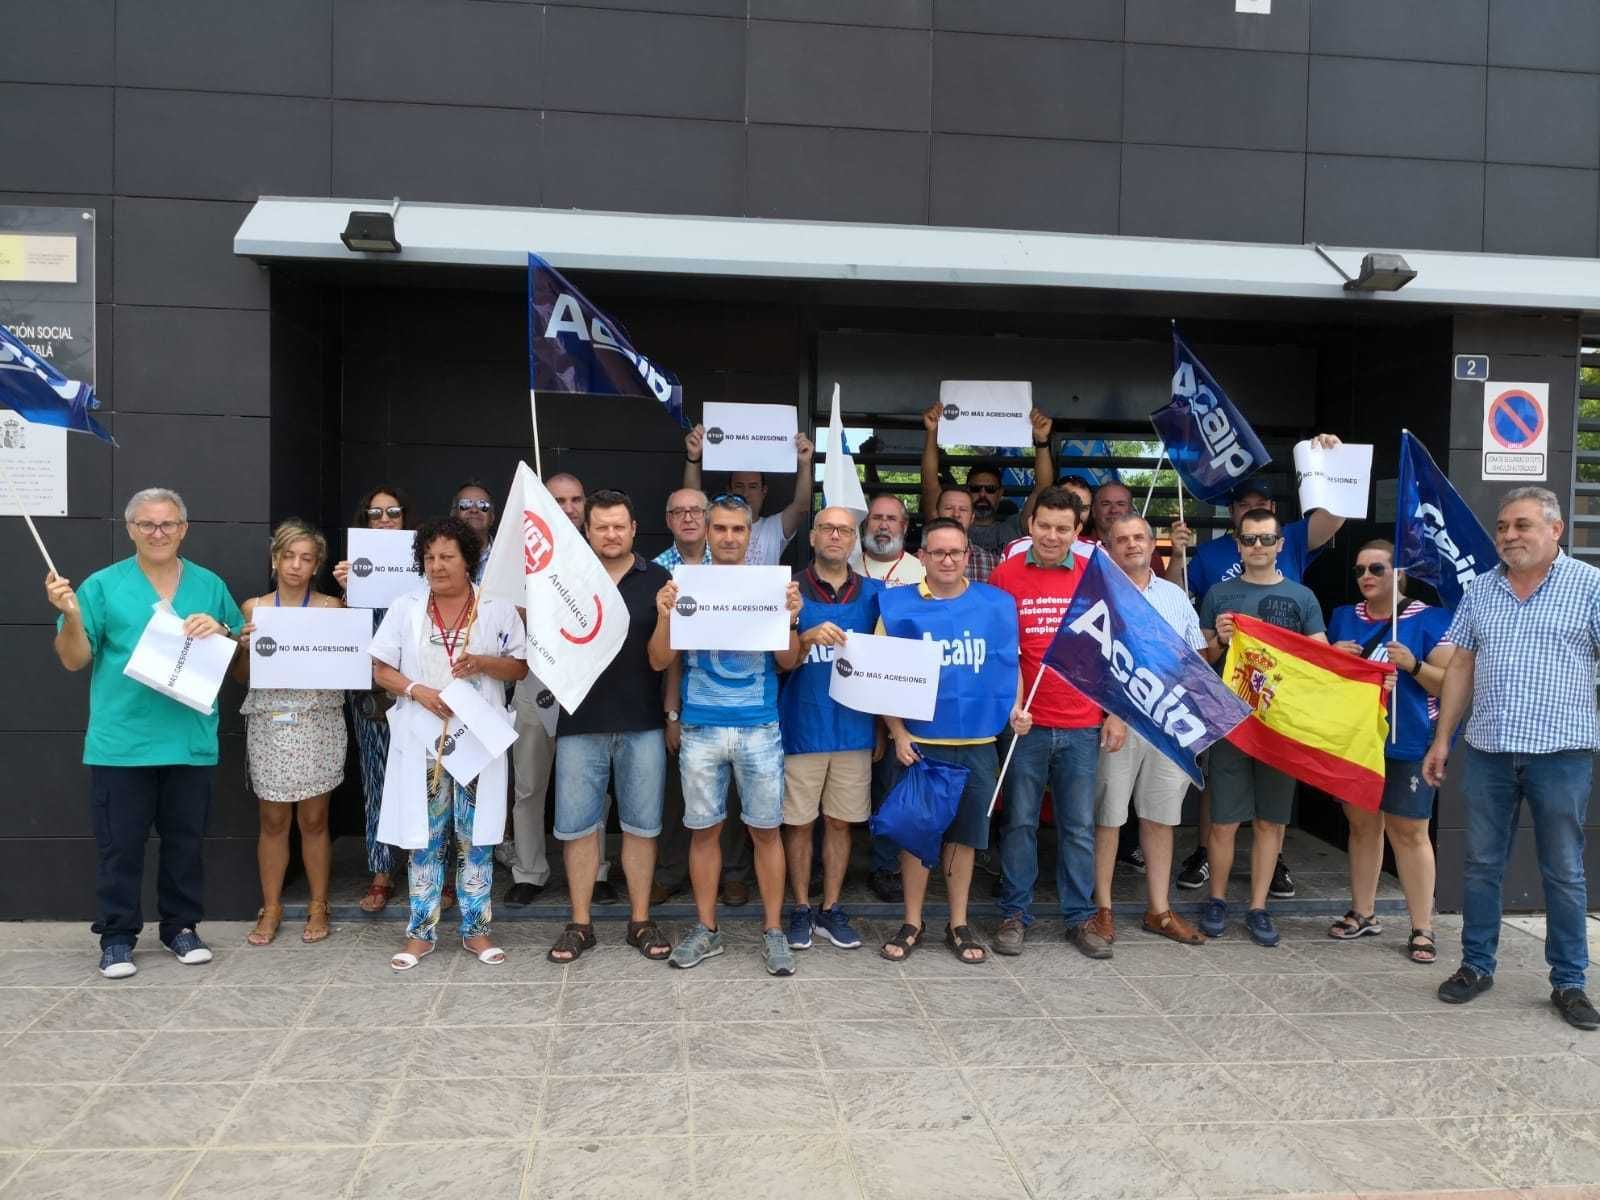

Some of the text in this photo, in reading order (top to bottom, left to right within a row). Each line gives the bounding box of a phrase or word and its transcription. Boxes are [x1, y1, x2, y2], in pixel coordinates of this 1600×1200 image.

[37, 325, 73, 340] SOCIAL
[27, 341, 54, 358] TALÁ
[1466, 359, 1477, 376] 2
[751, 434, 788, 442] AGRESIONES
[548, 573, 589, 629] Andalucía
[699, 604, 710, 612] NO
[732, 604, 778, 612] AGRESIONES
[1022, 598, 1034, 606] En
[1019, 607, 1058, 616] sistema
[312, 645, 359, 653] AGRESIONES
[837, 660, 853, 673] STOP
[853, 669, 865, 678] NO
[884, 673, 927, 684] AGRESIONES
[1068, 599, 1207, 748] Acaip
